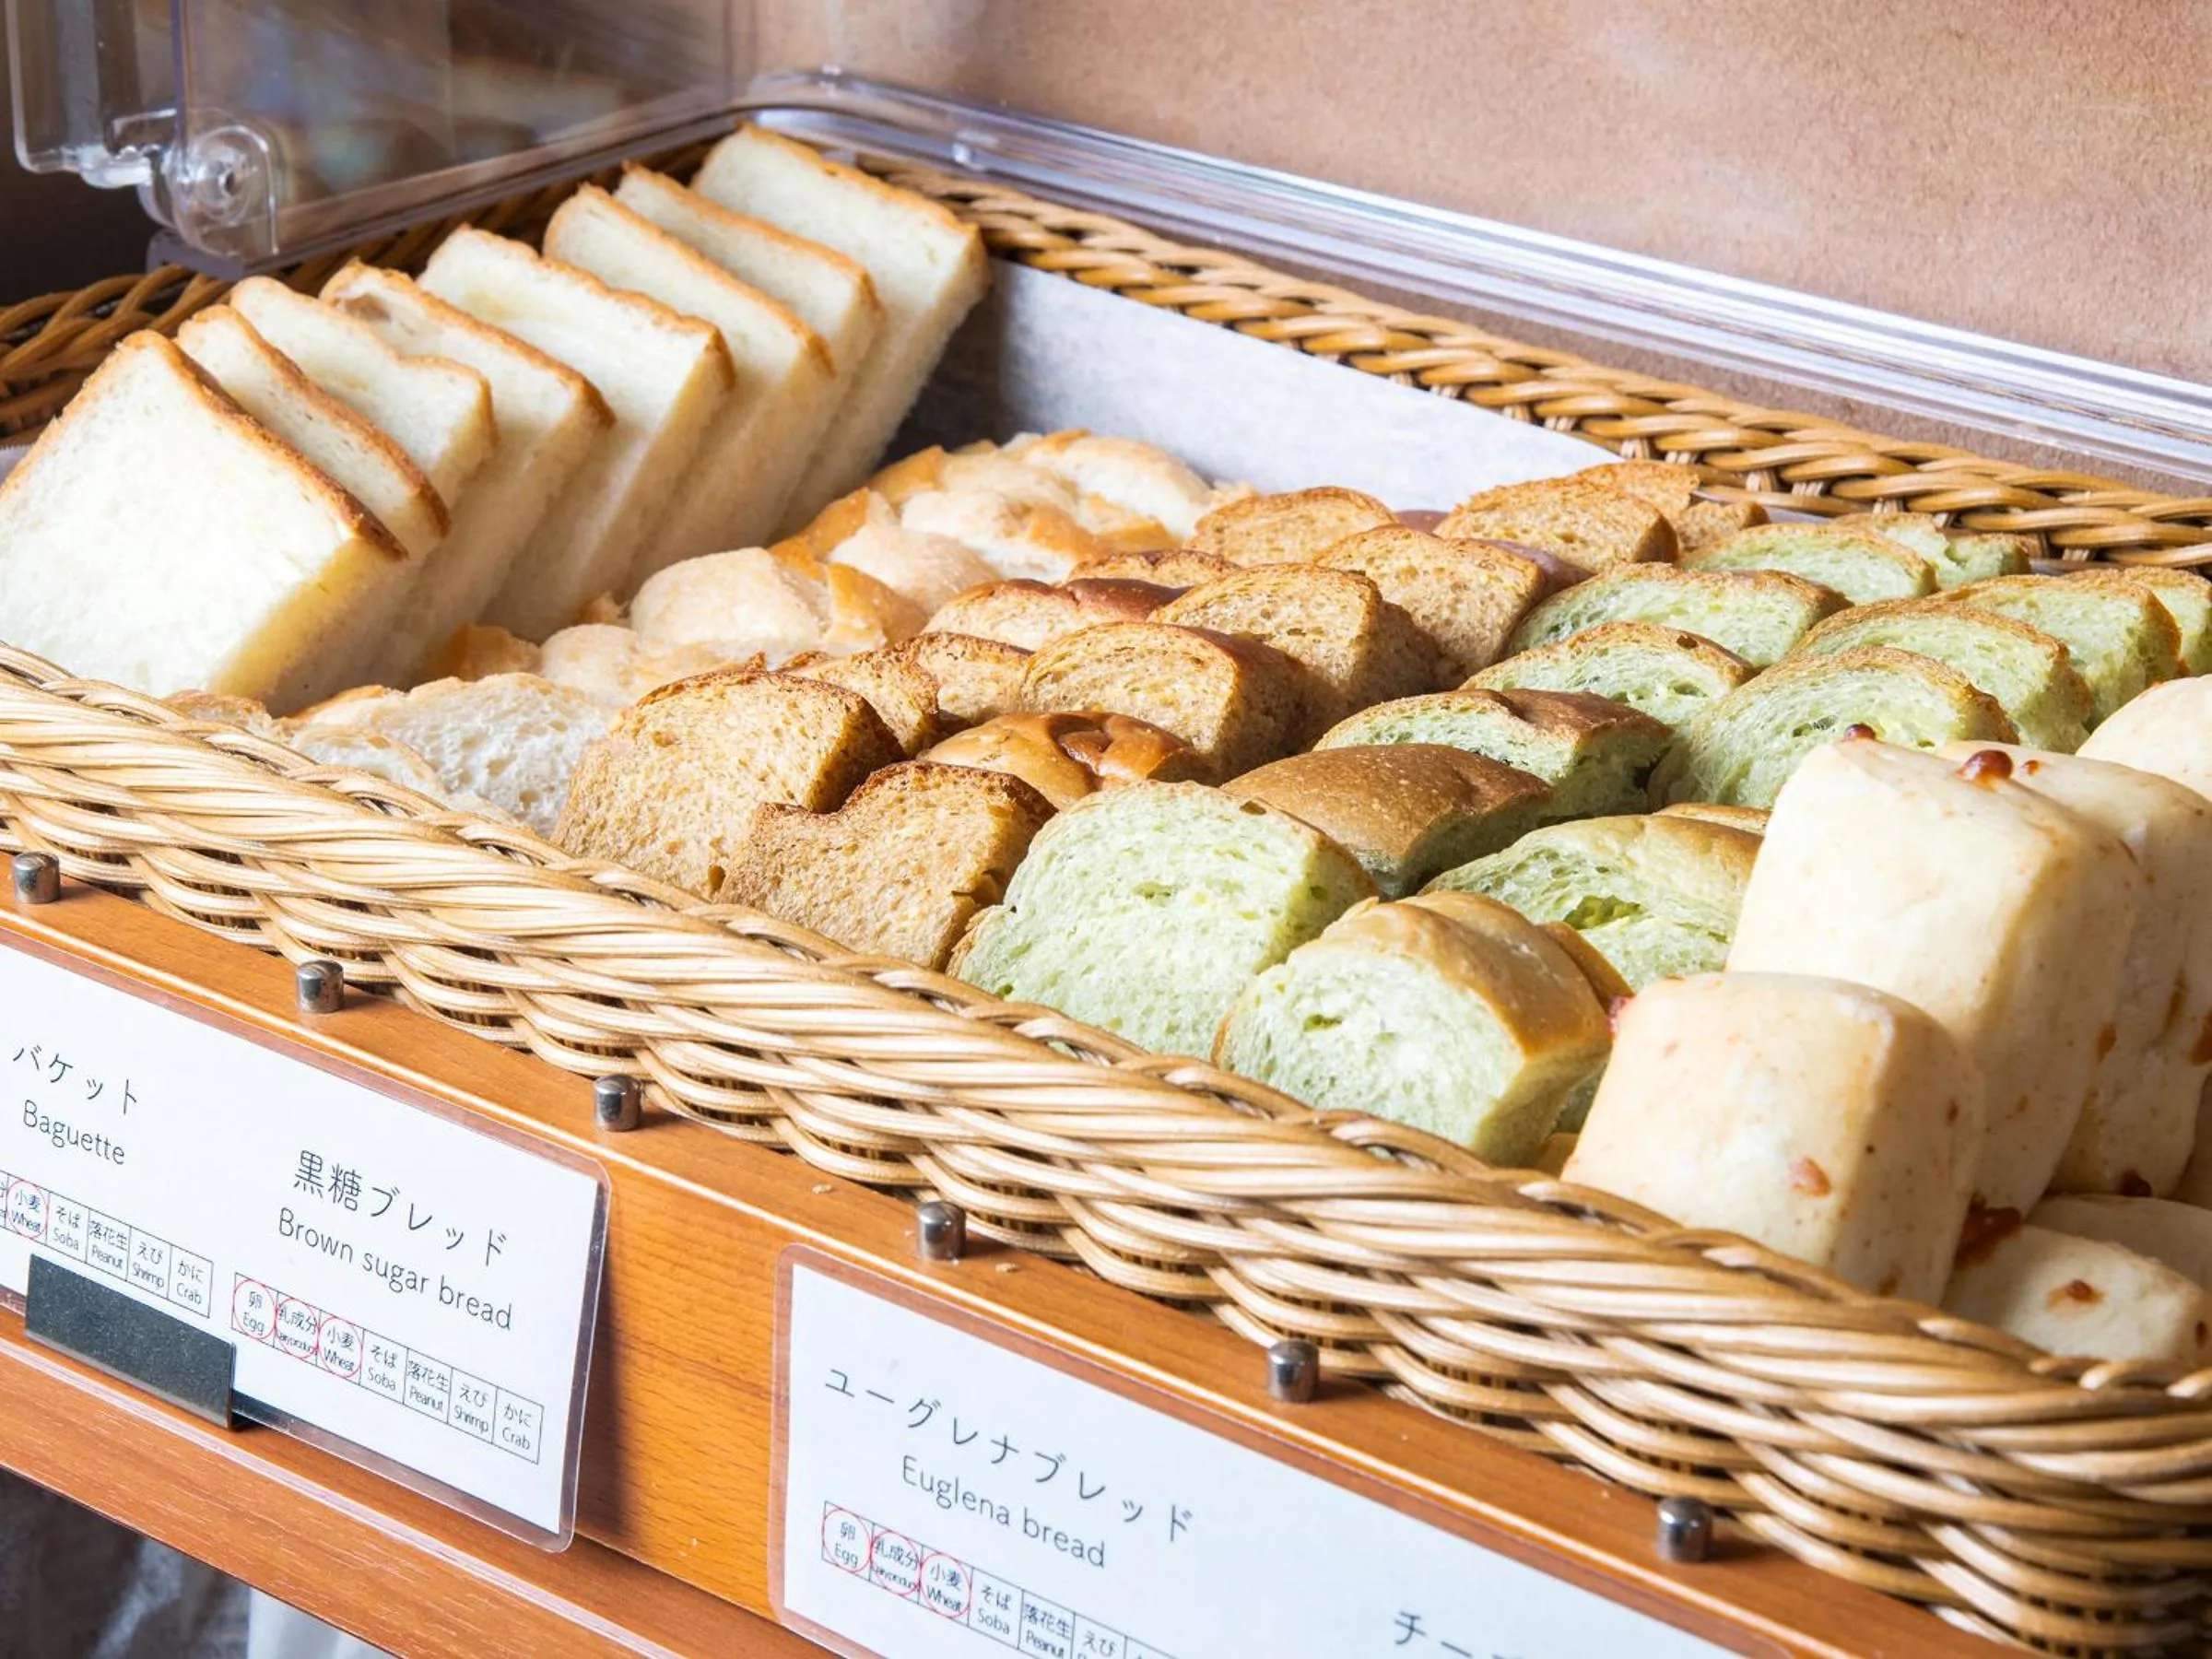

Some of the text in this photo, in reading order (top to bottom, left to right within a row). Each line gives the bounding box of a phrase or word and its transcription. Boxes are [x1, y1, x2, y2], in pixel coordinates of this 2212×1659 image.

[13, 1044, 137, 1115] バケット
[23, 1099, 125, 1165] Baguette
[11, 1209, 202, 1305] Wheat Soba Peanut Shrimp Crab
[15, 1189, 41, 1213] 小麦
[56, 1206, 81, 1229] そば
[89, 1219, 128, 1251] 落花生
[138, 1241, 163, 1265] えび
[178, 1259, 203, 1282] かに
[293, 1149, 508, 1267] 黒糖ブレッド
[278, 1206, 512, 1331] Brown sugar bread
[242, 1312, 531, 1451] Egg Wheat Soba Peanut Shrimp Crab
[248, 1290, 263, 1310] 卵
[278, 1305, 318, 1335] 乳成分
[326, 1324, 355, 1352] 小麦
[371, 1344, 397, 1367] そば
[406, 1359, 449, 1394] 落花生
[460, 1383, 488, 1408] えび
[503, 1403, 532, 1429] かに
[825, 1368, 1194, 1543] ユーグレナブレッド
[901, 1454, 1105, 1568] Euglena bread
[834, 1542, 1065, 1659] Egg Wheat Soba Peanut
[840, 1521, 856, 1541] 卵
[875, 1538, 918, 1571] 乳成分
[930, 1562, 962, 1592] 小麦
[982, 1584, 1011, 1612] そば
[1023, 1603, 1072, 1641] 落花生
[1083, 1629, 1117, 1658] えび
[1394, 1610, 1524, 1659] チー
